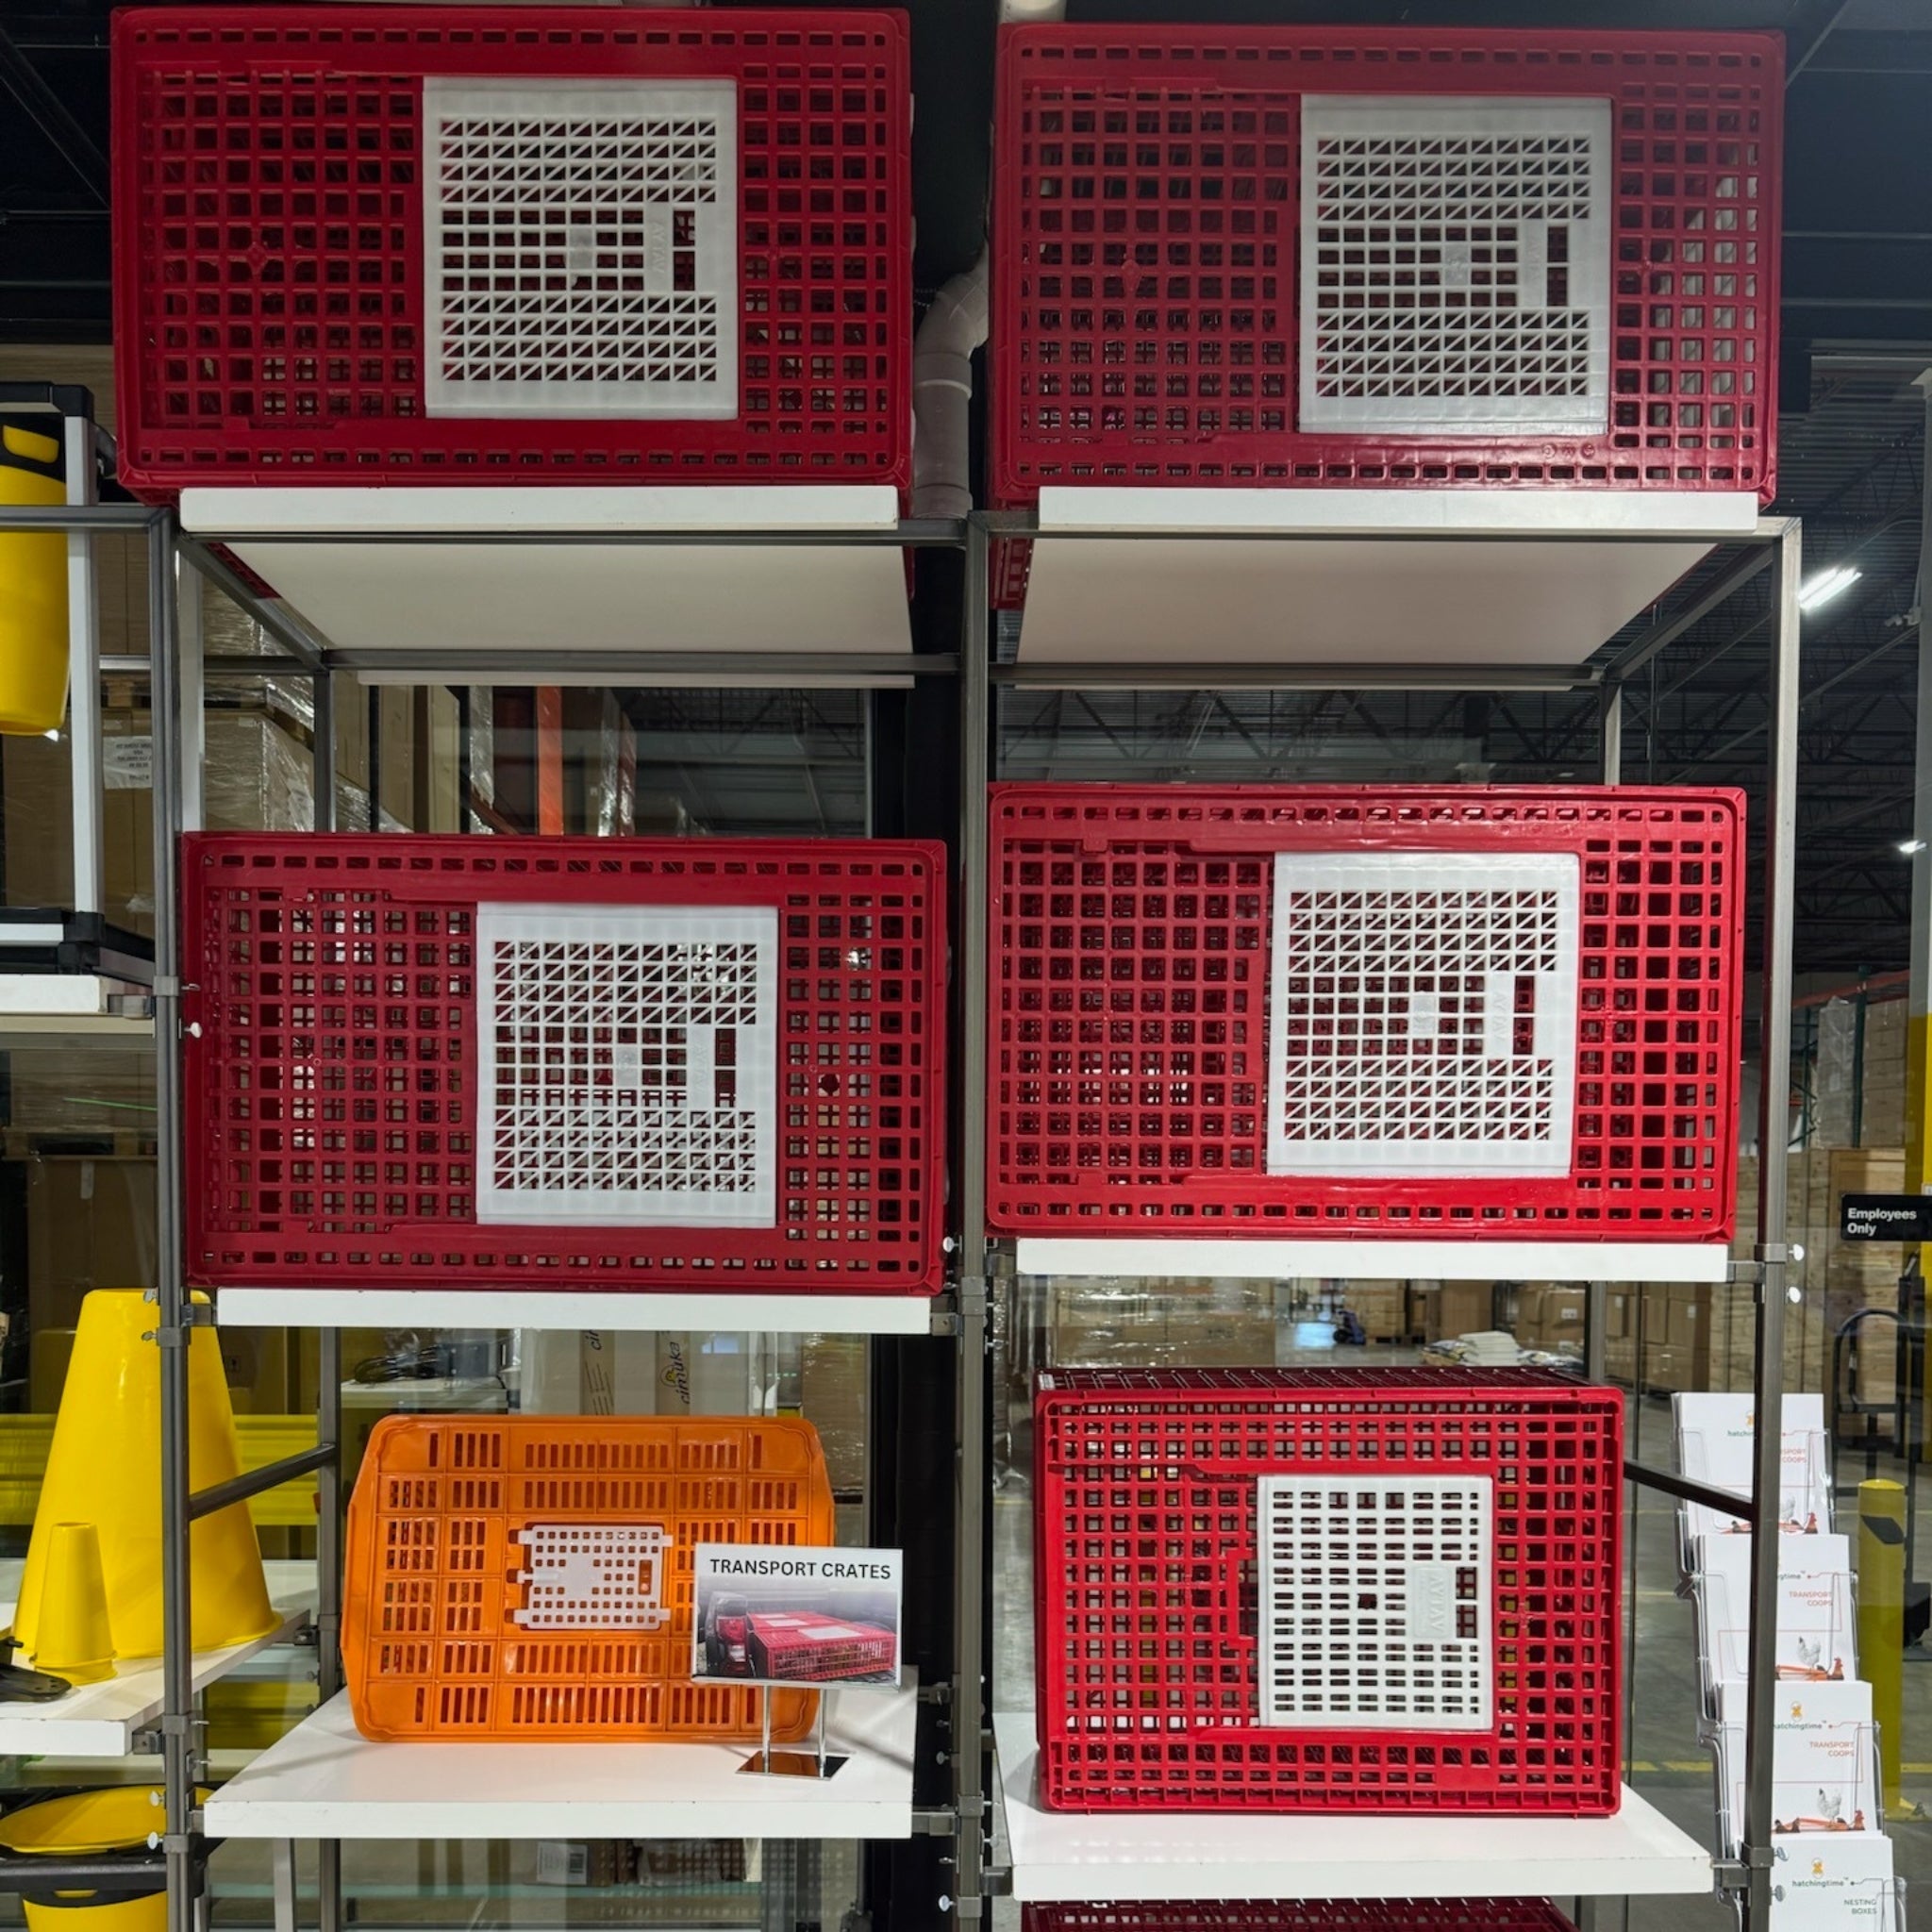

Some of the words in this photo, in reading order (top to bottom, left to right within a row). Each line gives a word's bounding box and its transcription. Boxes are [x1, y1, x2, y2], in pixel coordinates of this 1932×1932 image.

[1848, 1208, 1917, 1223] Employees
[1847, 1223, 1877, 1237] Only
[710, 1558, 817, 1576] TRANSPORT
[822, 1562, 891, 1580] CRATES
[1789, 1591, 1832, 1599] TRANSPORT
[1428, 1574, 1445, 1633] AYTAV
[1809, 1740, 1855, 1749] TRANSPORT
[1828, 1749, 1855, 1757] COOPS
[1843, 1898, 1877, 1907] NESTING
[1851, 1907, 1877, 1916] BOXES
